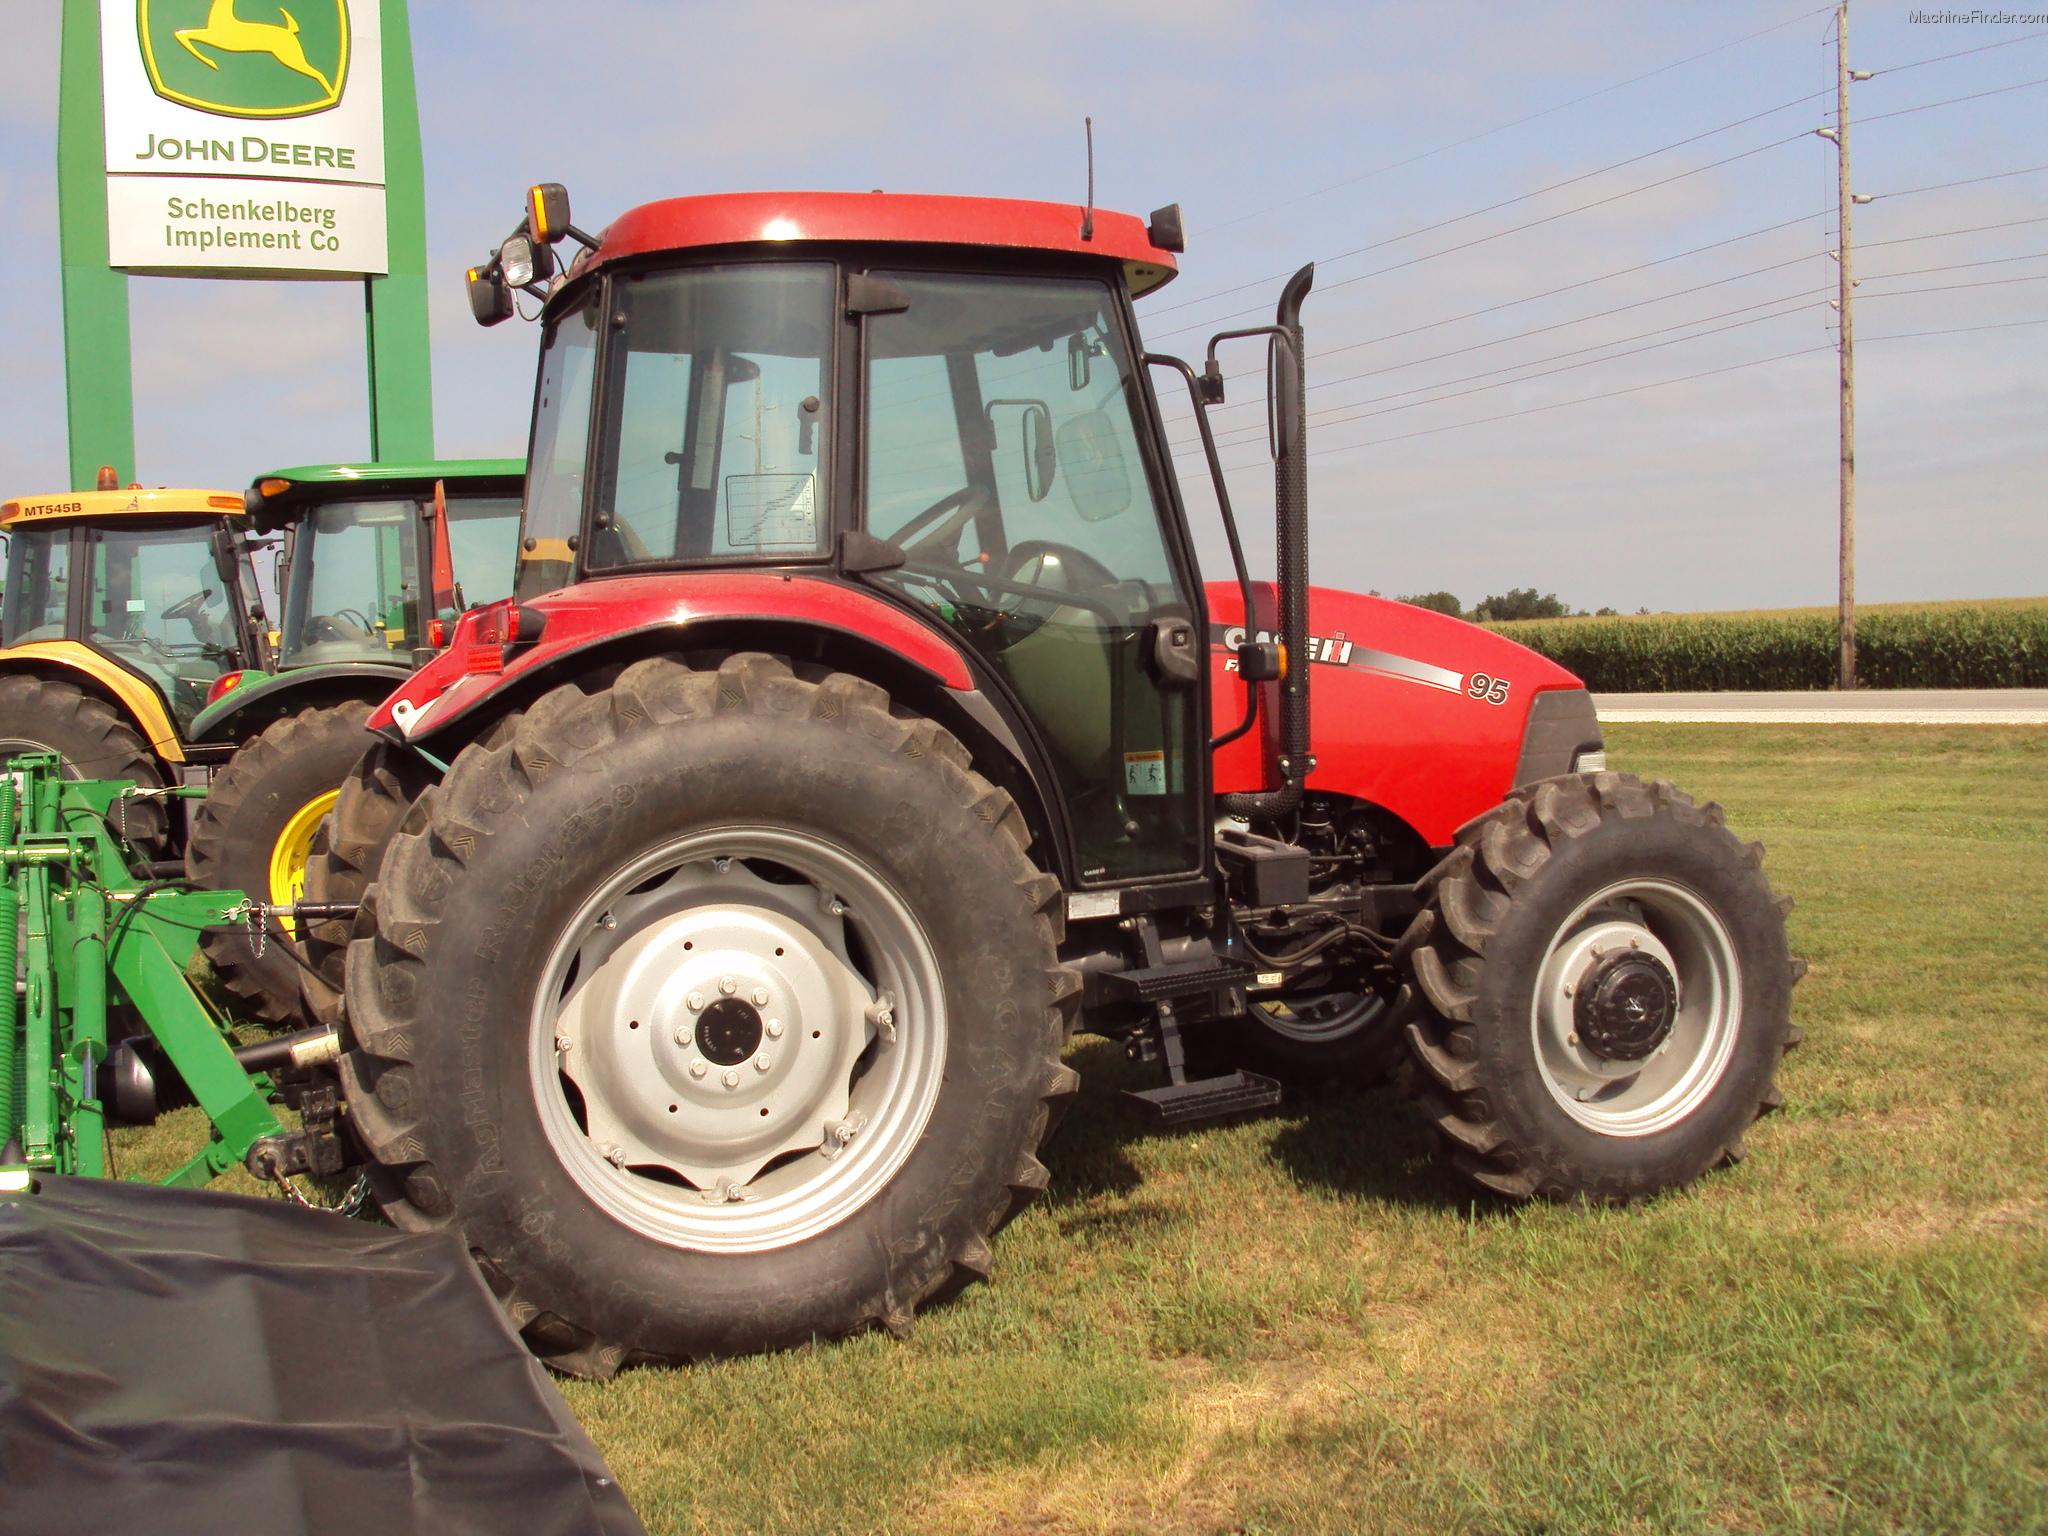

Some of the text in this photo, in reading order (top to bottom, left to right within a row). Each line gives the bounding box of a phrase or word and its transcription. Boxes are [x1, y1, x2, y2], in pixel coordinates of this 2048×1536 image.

[136, 134, 356, 169] JOHN DEERE
[167, 197, 336, 228] Schenkelberg
[165, 225, 340, 252] Implement Co
[25, 502, 82, 517] MT545B
[1224, 626, 1320, 661] CE
[1467, 672, 1511, 705] 95
[475, 842, 562, 964] Radial
